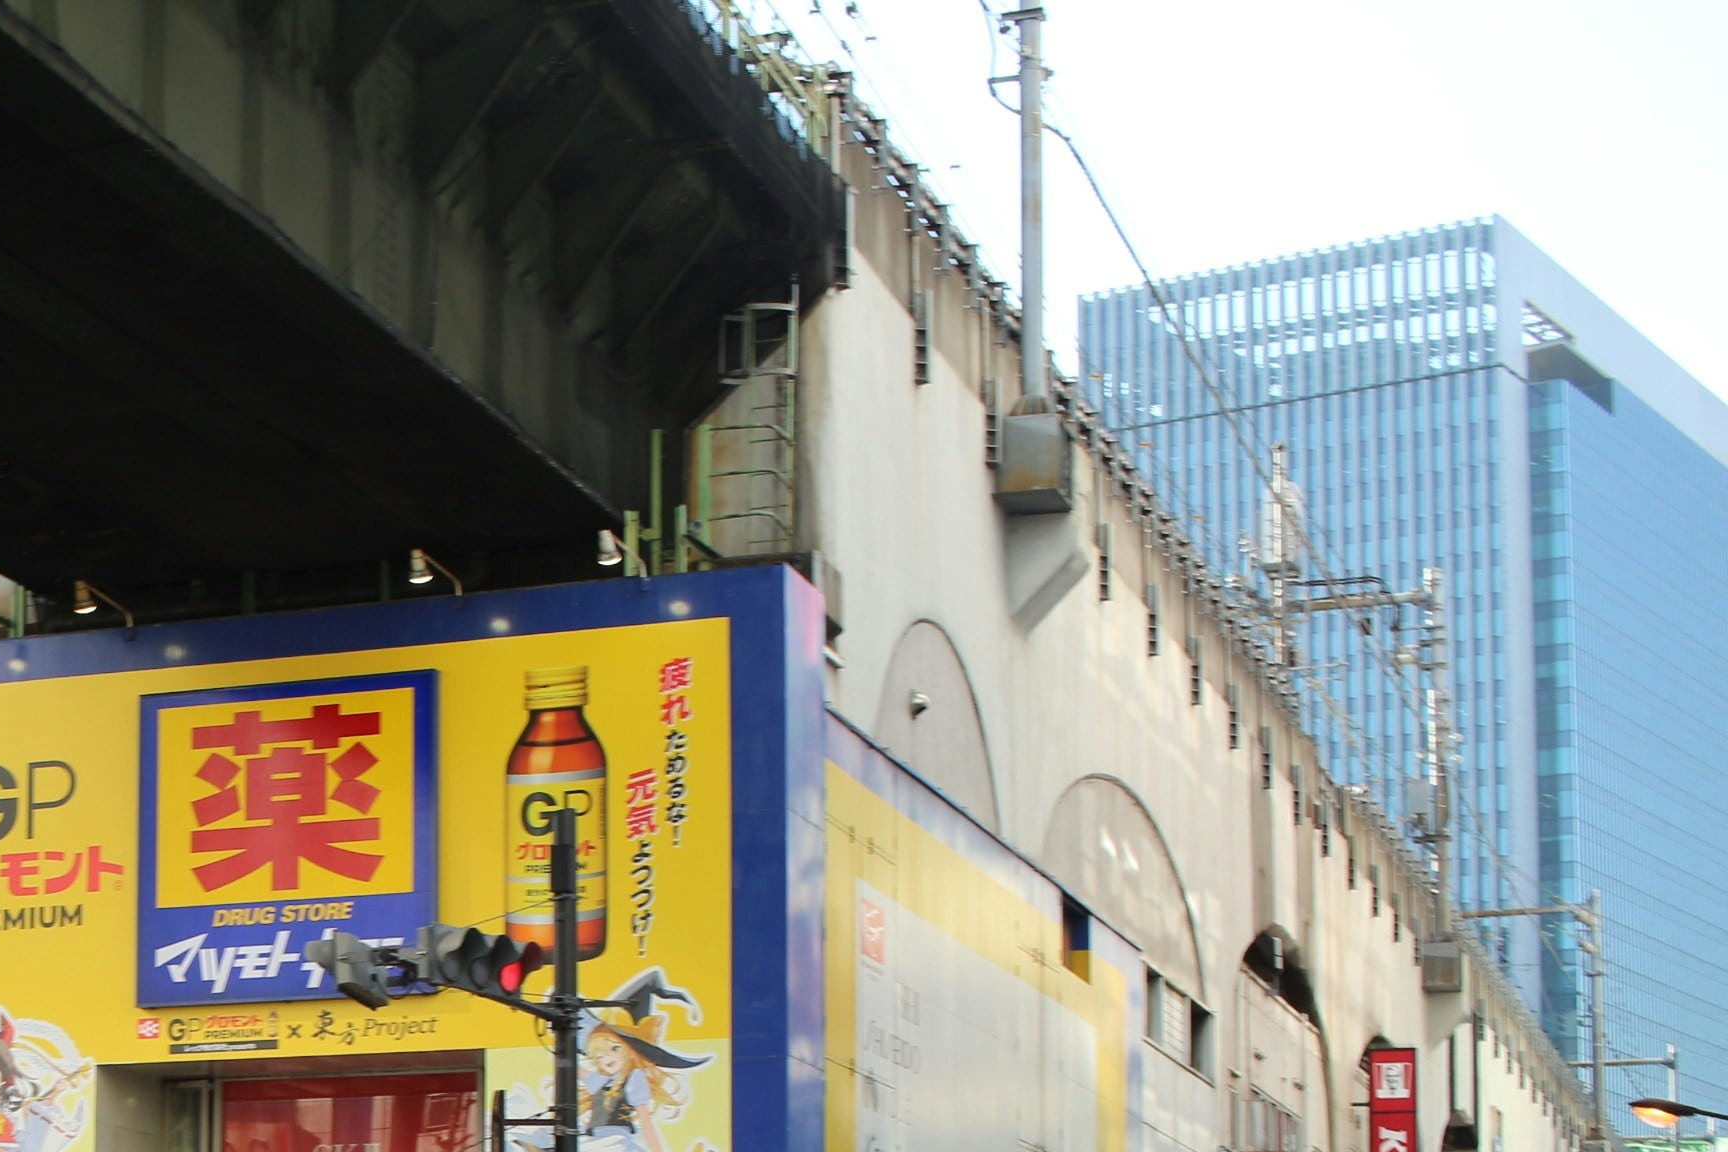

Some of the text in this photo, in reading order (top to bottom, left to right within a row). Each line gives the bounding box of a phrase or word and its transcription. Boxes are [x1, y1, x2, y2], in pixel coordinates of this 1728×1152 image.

[190, 703, 384, 892] 薬
[212, 902, 354, 927] DRUG STORE
